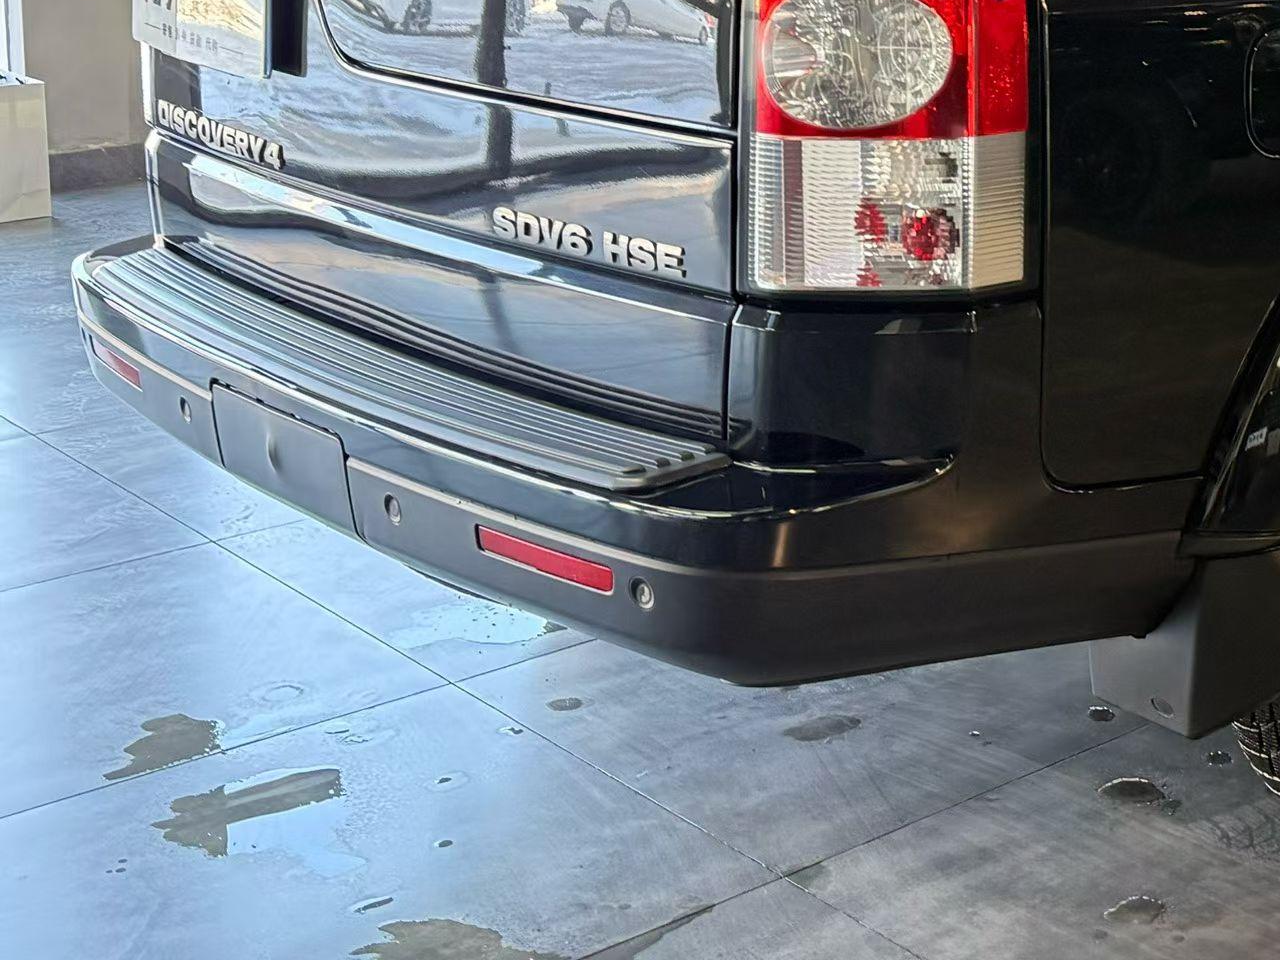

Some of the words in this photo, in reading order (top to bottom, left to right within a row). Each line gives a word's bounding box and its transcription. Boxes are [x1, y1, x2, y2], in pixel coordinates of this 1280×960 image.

[157, 99, 266, 165] DISCOVERY
[493, 206, 593, 256] SDV6
[603, 231, 687, 278] HSE
